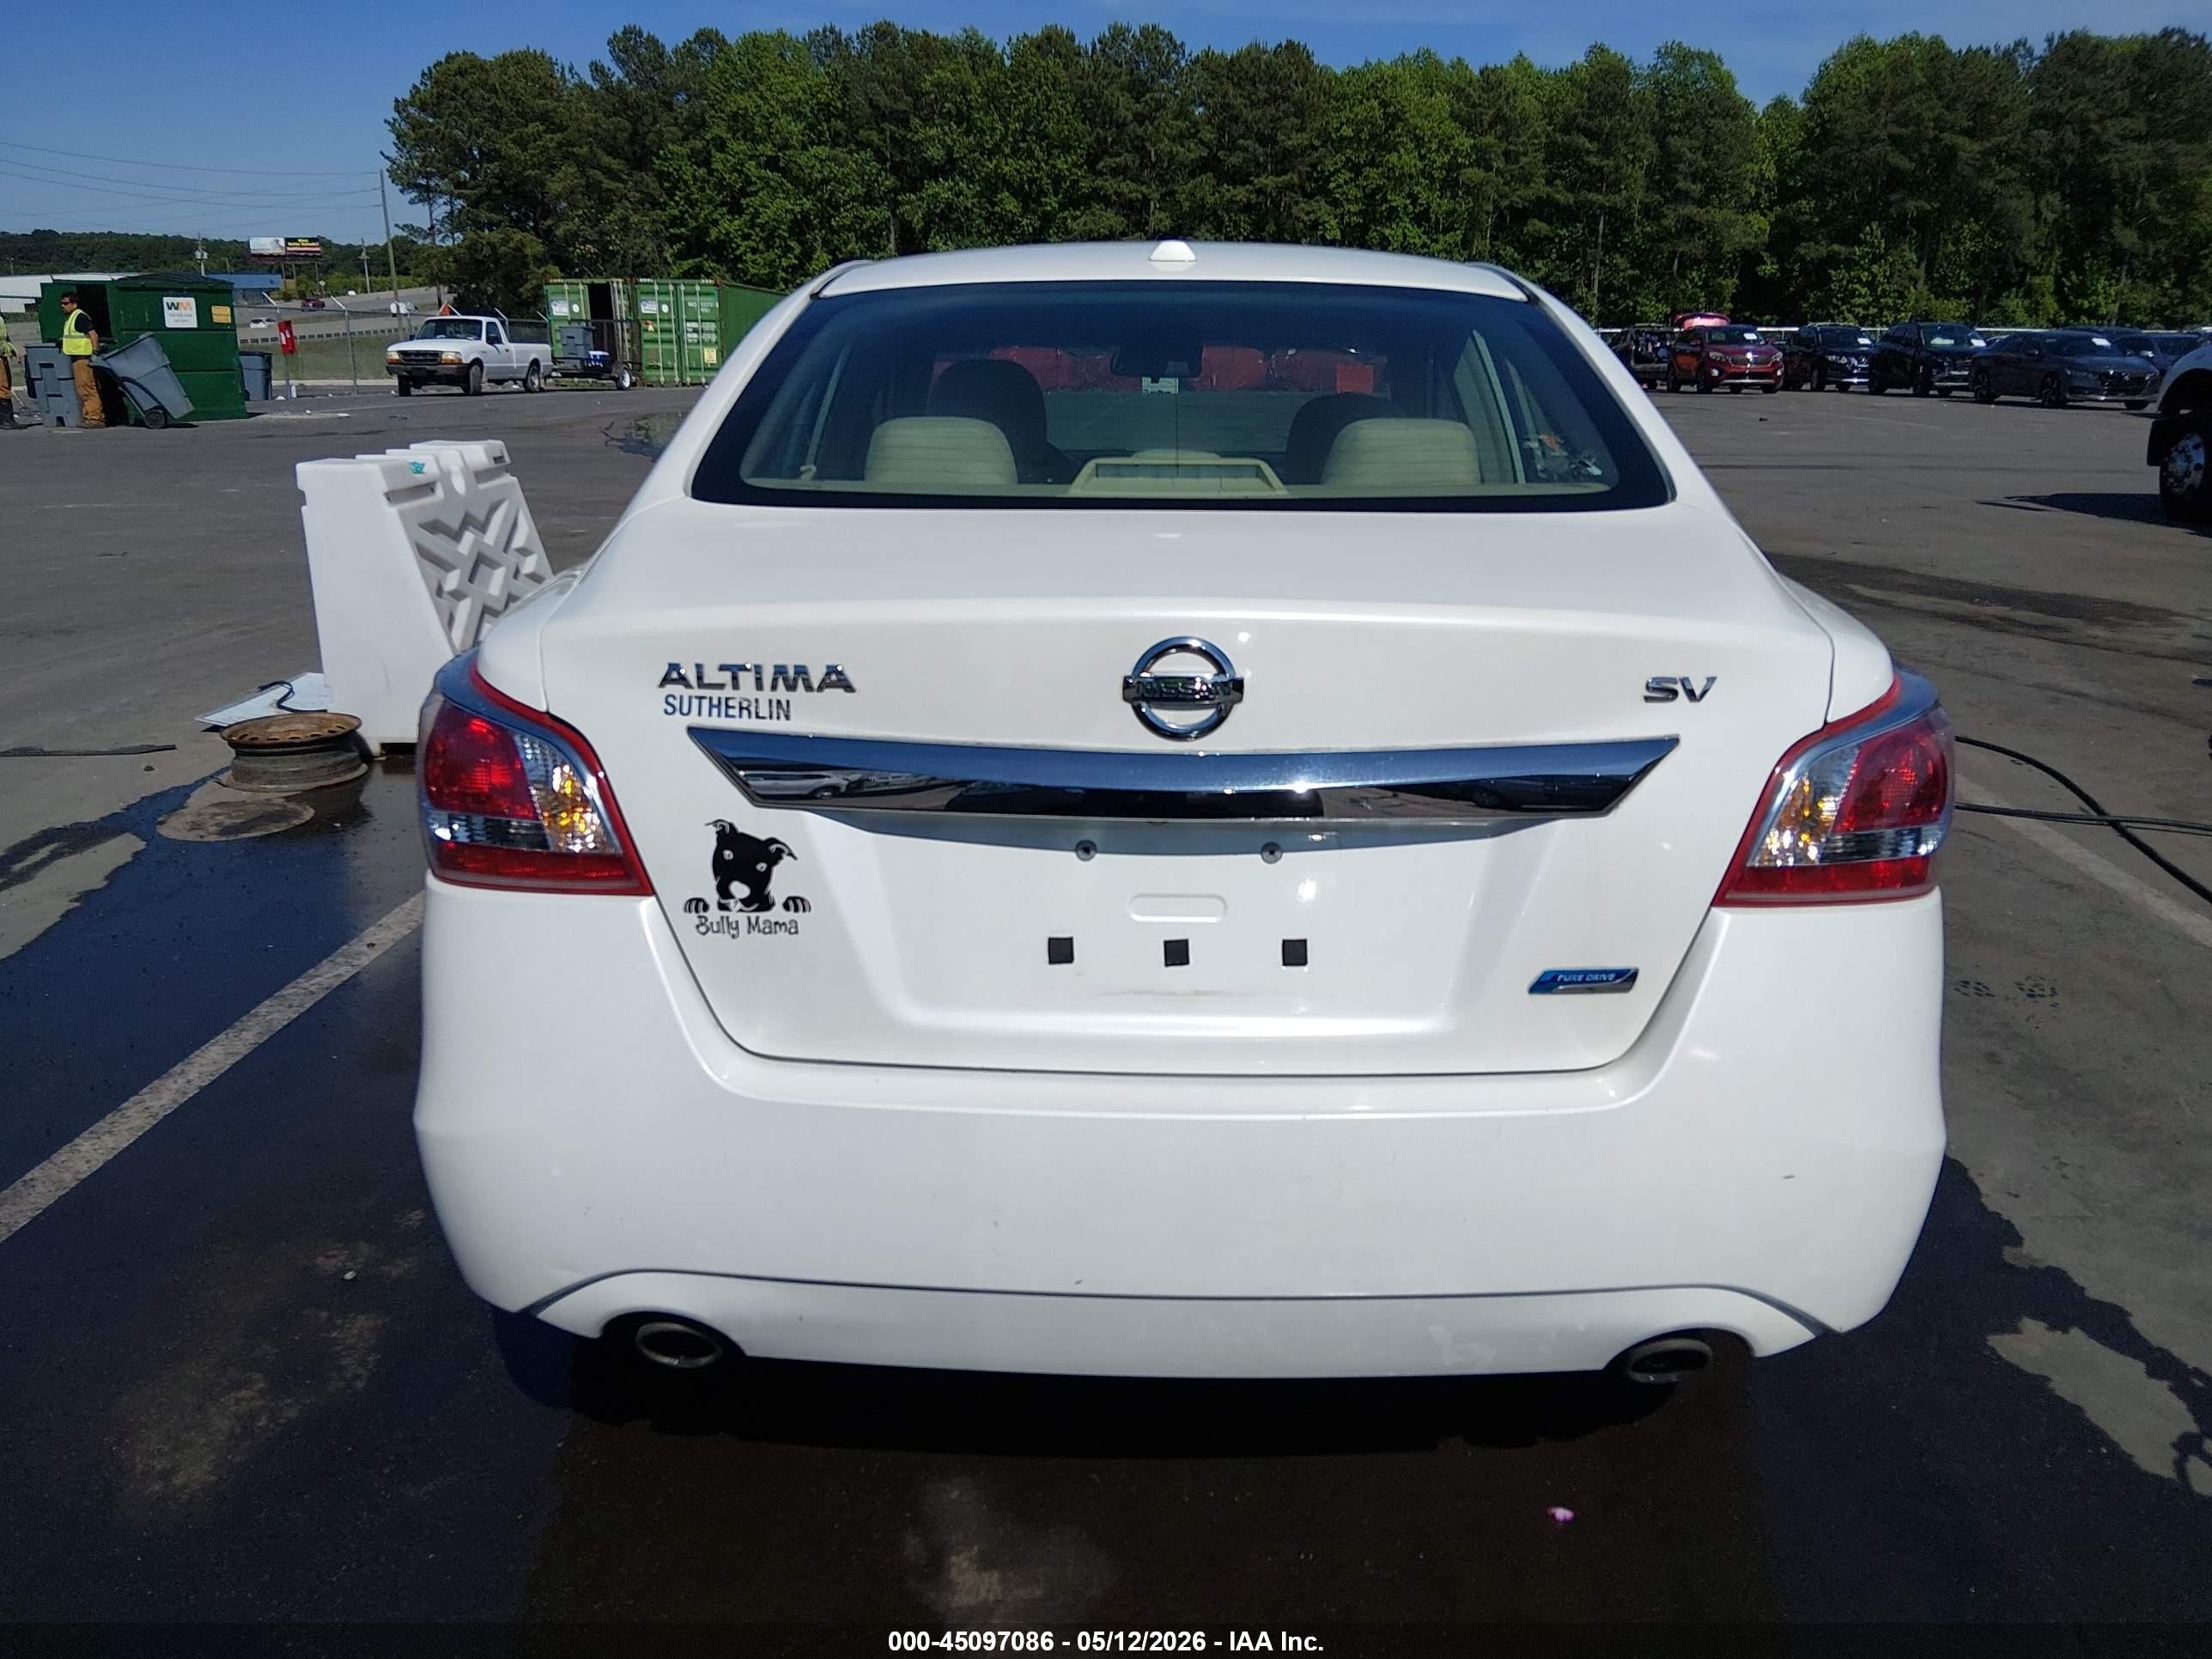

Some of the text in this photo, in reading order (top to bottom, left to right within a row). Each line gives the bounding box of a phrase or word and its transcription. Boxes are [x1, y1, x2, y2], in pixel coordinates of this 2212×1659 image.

[167, 302, 193, 311] WM
[658, 662, 856, 693] ALTIMA
[1643, 677, 1717, 703] SV
[664, 694, 791, 720] SUTHERLIN
[696, 915, 799, 940] Bully Mama
[1586, 973, 1616, 981] DRIVE
